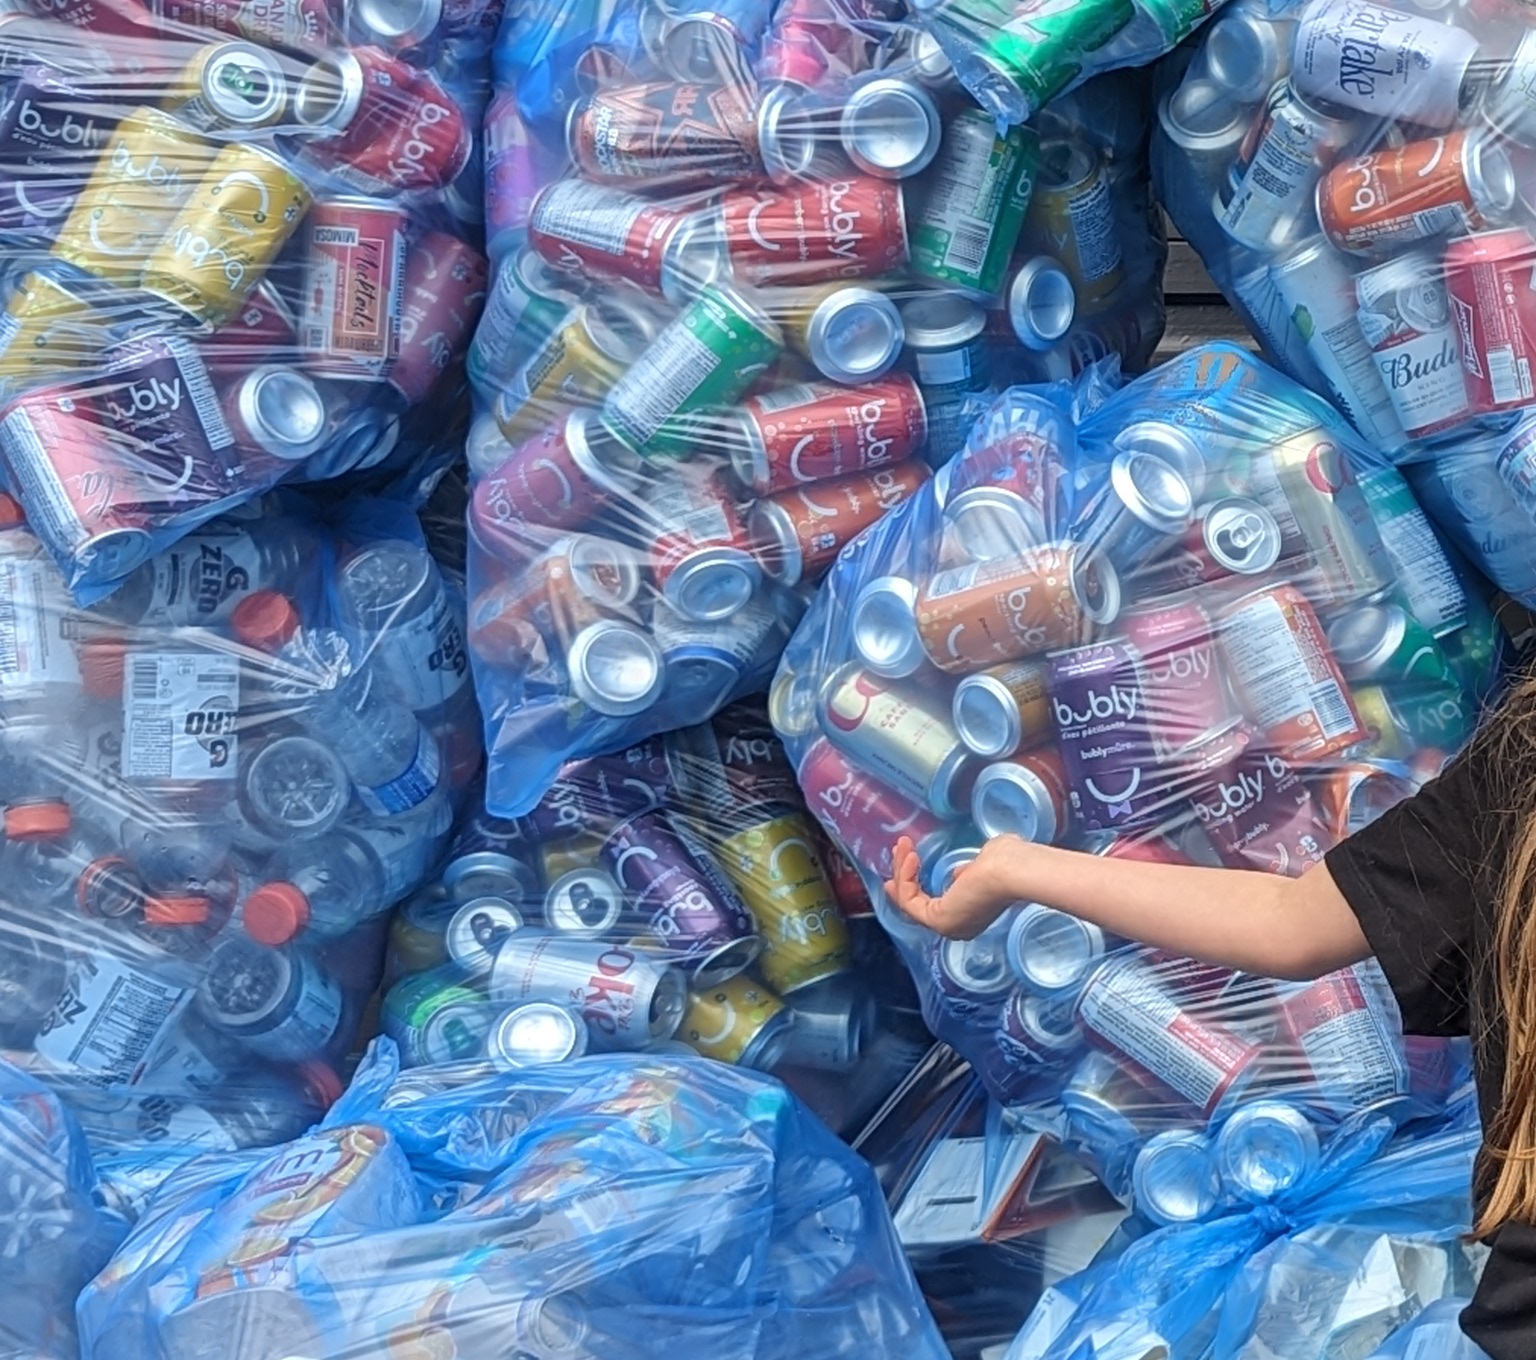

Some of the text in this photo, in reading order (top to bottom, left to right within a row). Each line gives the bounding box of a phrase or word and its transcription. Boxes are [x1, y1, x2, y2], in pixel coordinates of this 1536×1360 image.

[215, 2, 226, 28] SOD
[252, 3, 267, 37] DRY
[391, 104, 451, 189] bubly
[1347, 154, 1375, 211] bub
[315, 225, 357, 244] MIMOSA
[829, 181, 864, 259] bubly
[173, 226, 246, 289] bubly
[348, 241, 381, 329] Mocktails
[865, 400, 897, 467] bubl
[874, 468, 908, 510] bly
[194, 543, 224, 614] ZERO
[224, 564, 250, 592] G
[1007, 586, 1047, 646] bub
[1150, 646, 1210, 682] ubly
[1053, 683, 1138, 726] bubly
[1417, 699, 1462, 732] bly
[208, 738, 228, 768] G
[725, 736, 771, 764] bly
[780, 904, 839, 945] ubly
